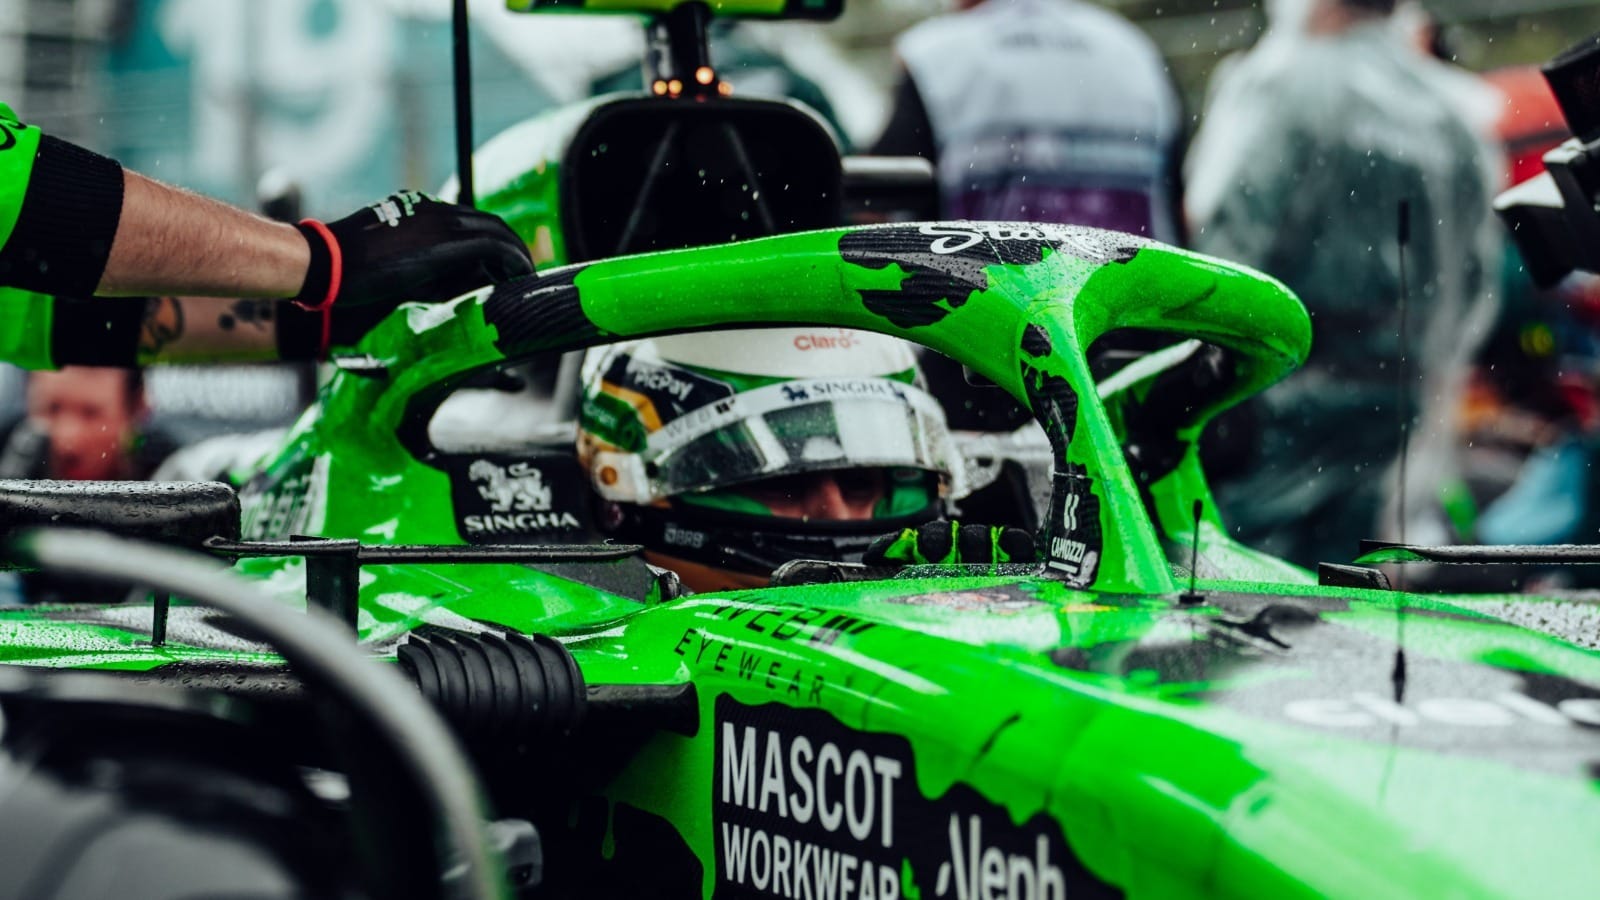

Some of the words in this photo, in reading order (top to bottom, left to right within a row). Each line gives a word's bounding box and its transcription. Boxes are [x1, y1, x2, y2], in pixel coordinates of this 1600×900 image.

[793, 332, 852, 351] Claro
[634, 367, 694, 401] PicPay
[812, 382, 886, 395] SINGHA
[464, 513, 580, 534] SINGHA
[1051, 536, 1087, 564] CAMOZZI
[674, 628, 825, 704] EYEWEAR
[722, 721, 901, 848] MASCOT
